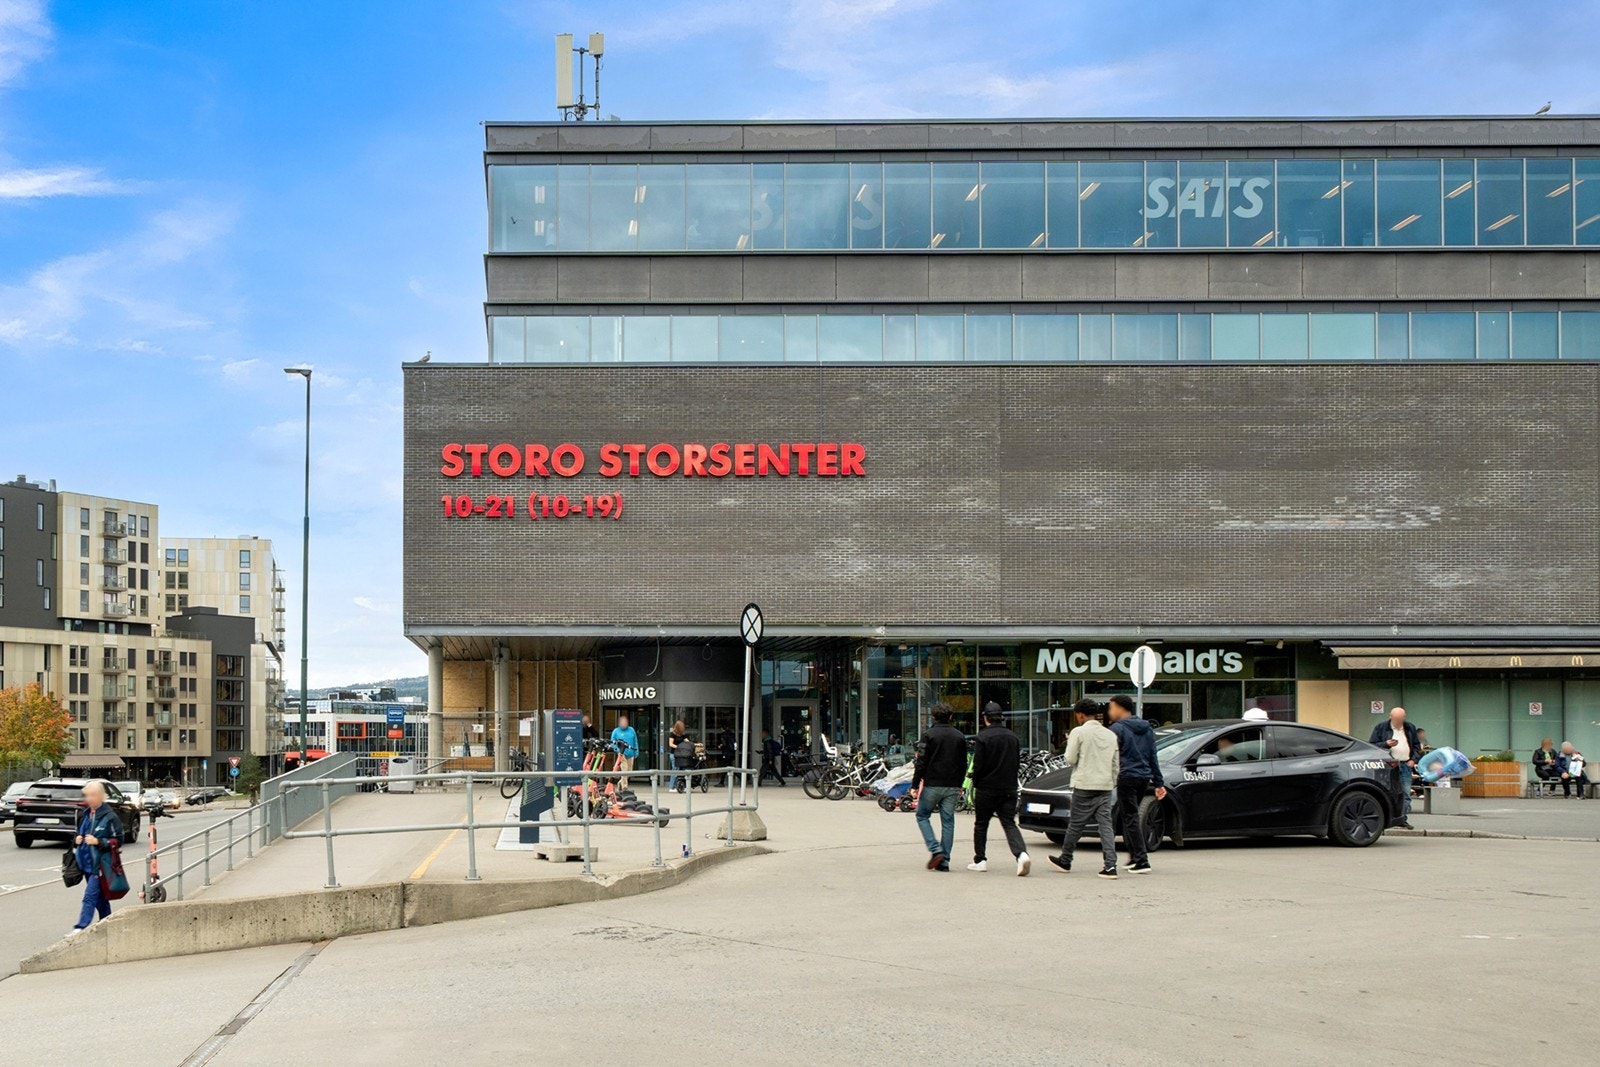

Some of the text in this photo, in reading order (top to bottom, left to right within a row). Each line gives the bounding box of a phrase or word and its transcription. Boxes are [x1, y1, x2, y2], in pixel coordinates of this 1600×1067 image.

[738, 184, 885, 230] SS
[1138, 177, 1271, 218] SATS
[441, 443, 866, 477] STORO STORSENTER
[441, 491, 623, 520] 10-21 (10-19)
[1350, 760, 1385, 771] mytaxi
